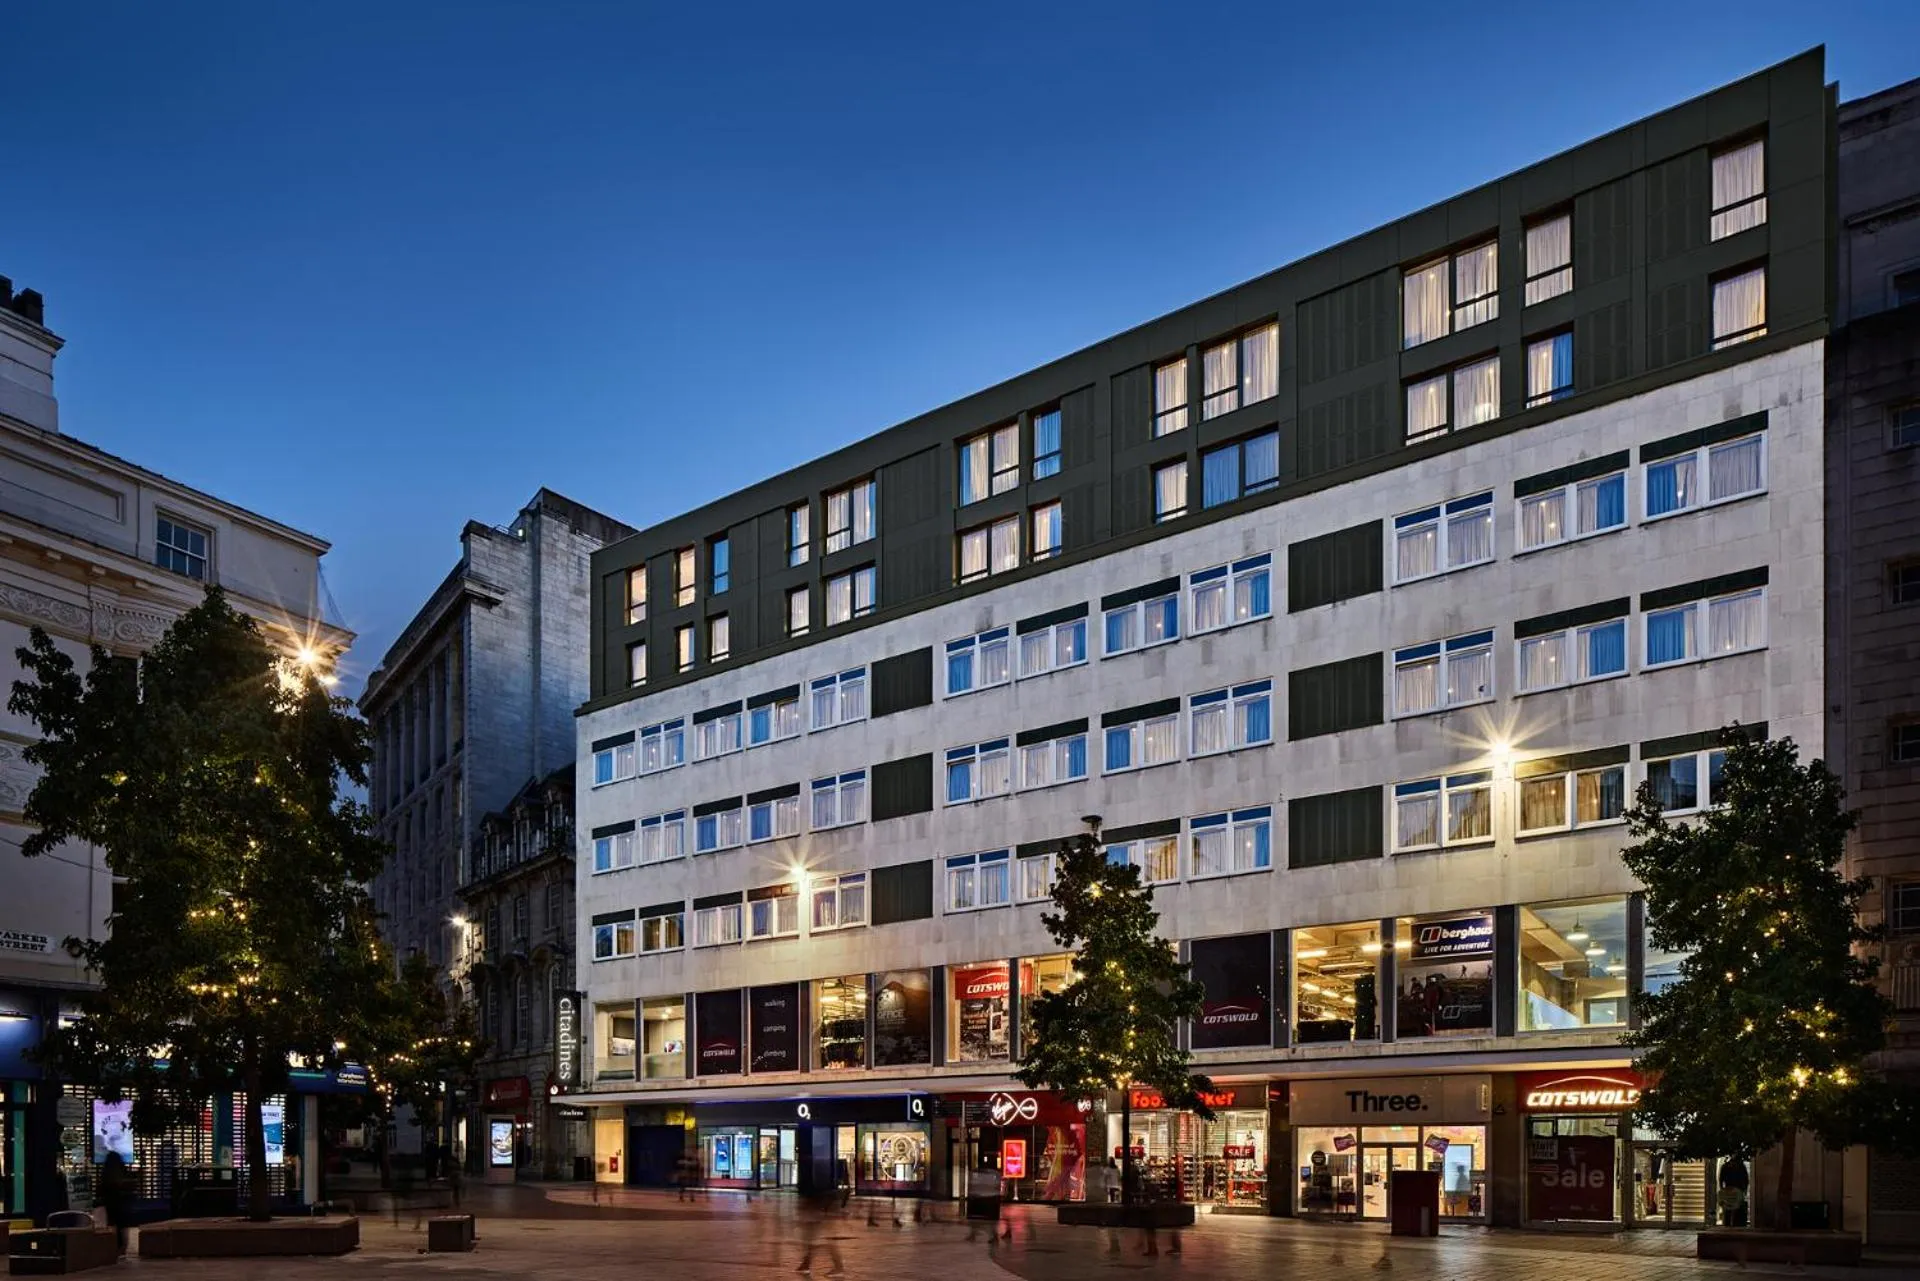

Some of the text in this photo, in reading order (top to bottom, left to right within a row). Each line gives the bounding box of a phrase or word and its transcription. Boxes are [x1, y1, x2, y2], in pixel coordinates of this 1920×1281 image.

[0, 931, 48, 944] ARKER
[1442, 926, 1493, 939] berghaus
[1424, 945, 1439, 954] LIVE
[1453, 941, 1490, 951] ADVENTURE
[966, 981, 1010, 994] COTSWO
[1203, 1012, 1259, 1024] COTSWOLD
[559, 997, 577, 1080] citadines
[703, 1049, 736, 1058] COTSWOLD
[1132, 1090, 1168, 1108] Foo
[1345, 1090, 1429, 1112] Three.
[1228, 1149, 1251, 1157] SALE
